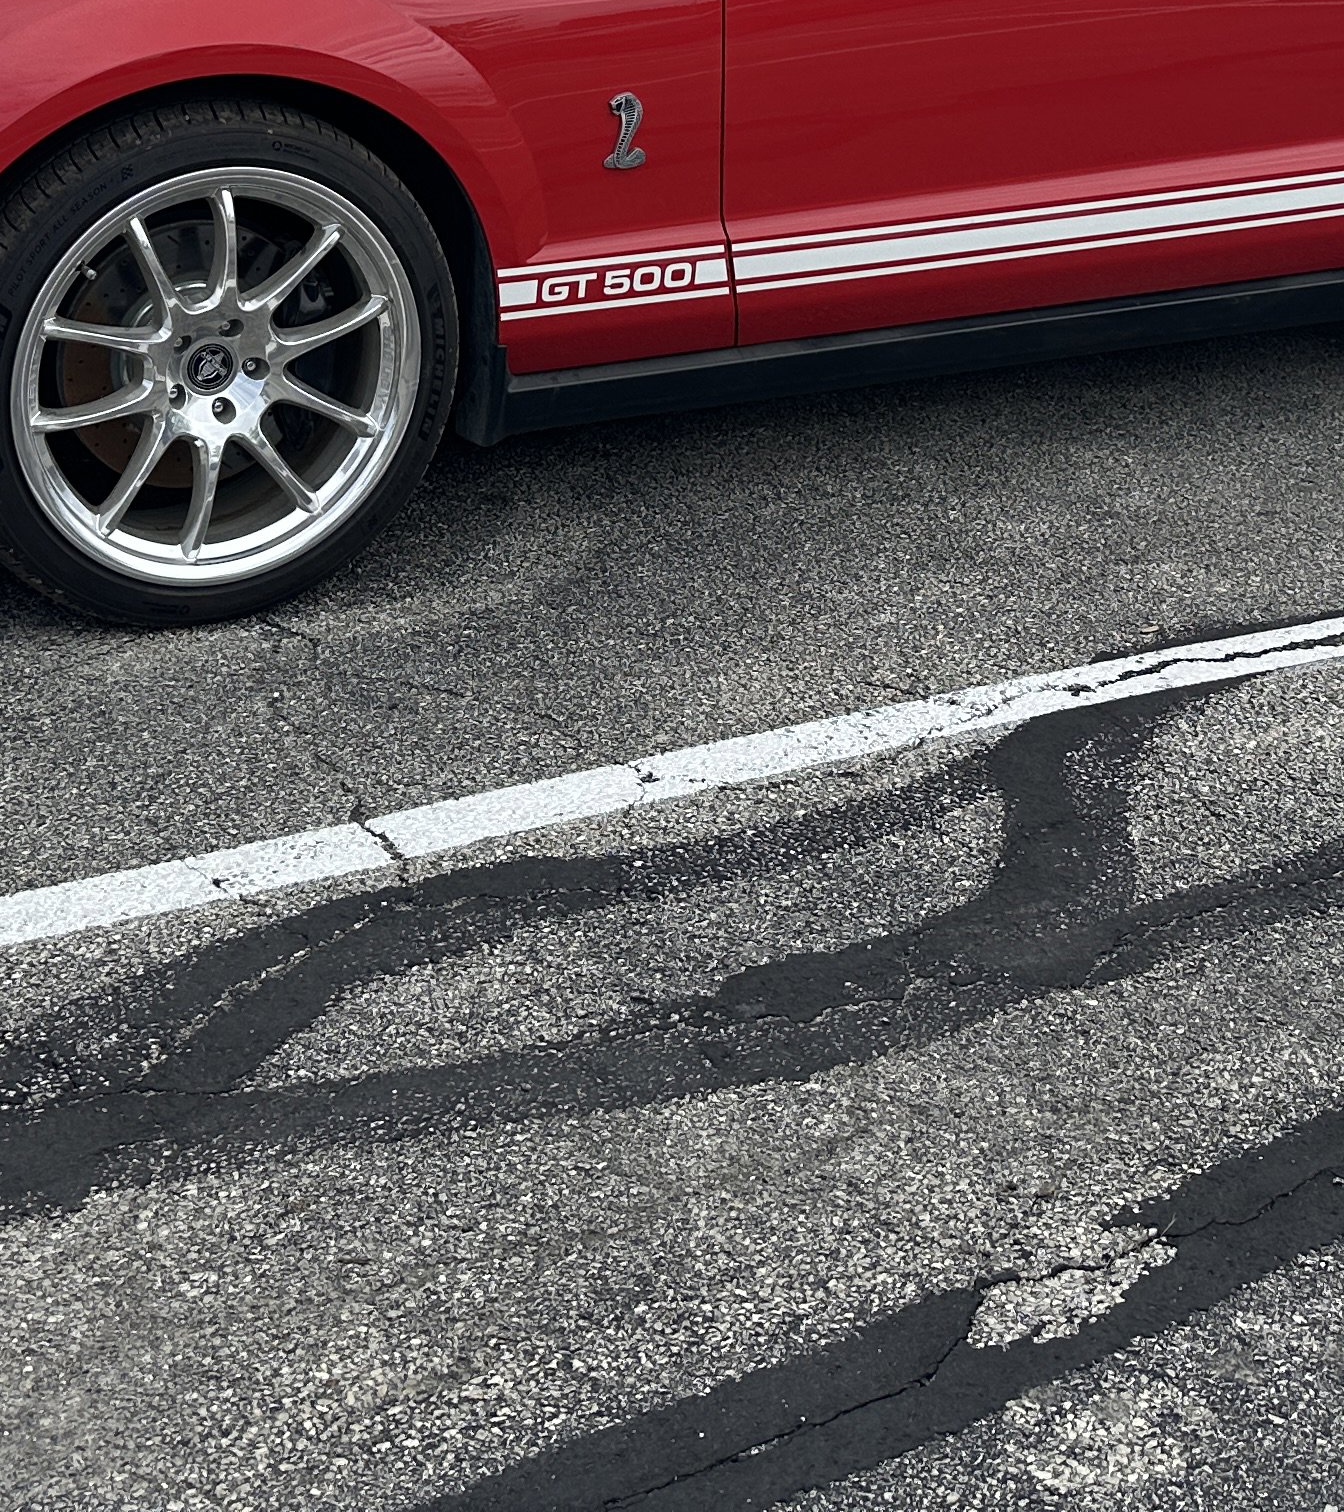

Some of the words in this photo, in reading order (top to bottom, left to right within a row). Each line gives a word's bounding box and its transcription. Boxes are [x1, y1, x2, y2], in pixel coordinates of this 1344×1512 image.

[26, 232, 51, 266] SPORT
[541, 272, 598, 302] GT
[603, 262, 693, 295] 500
[421, 316, 446, 437] MICHELIN
